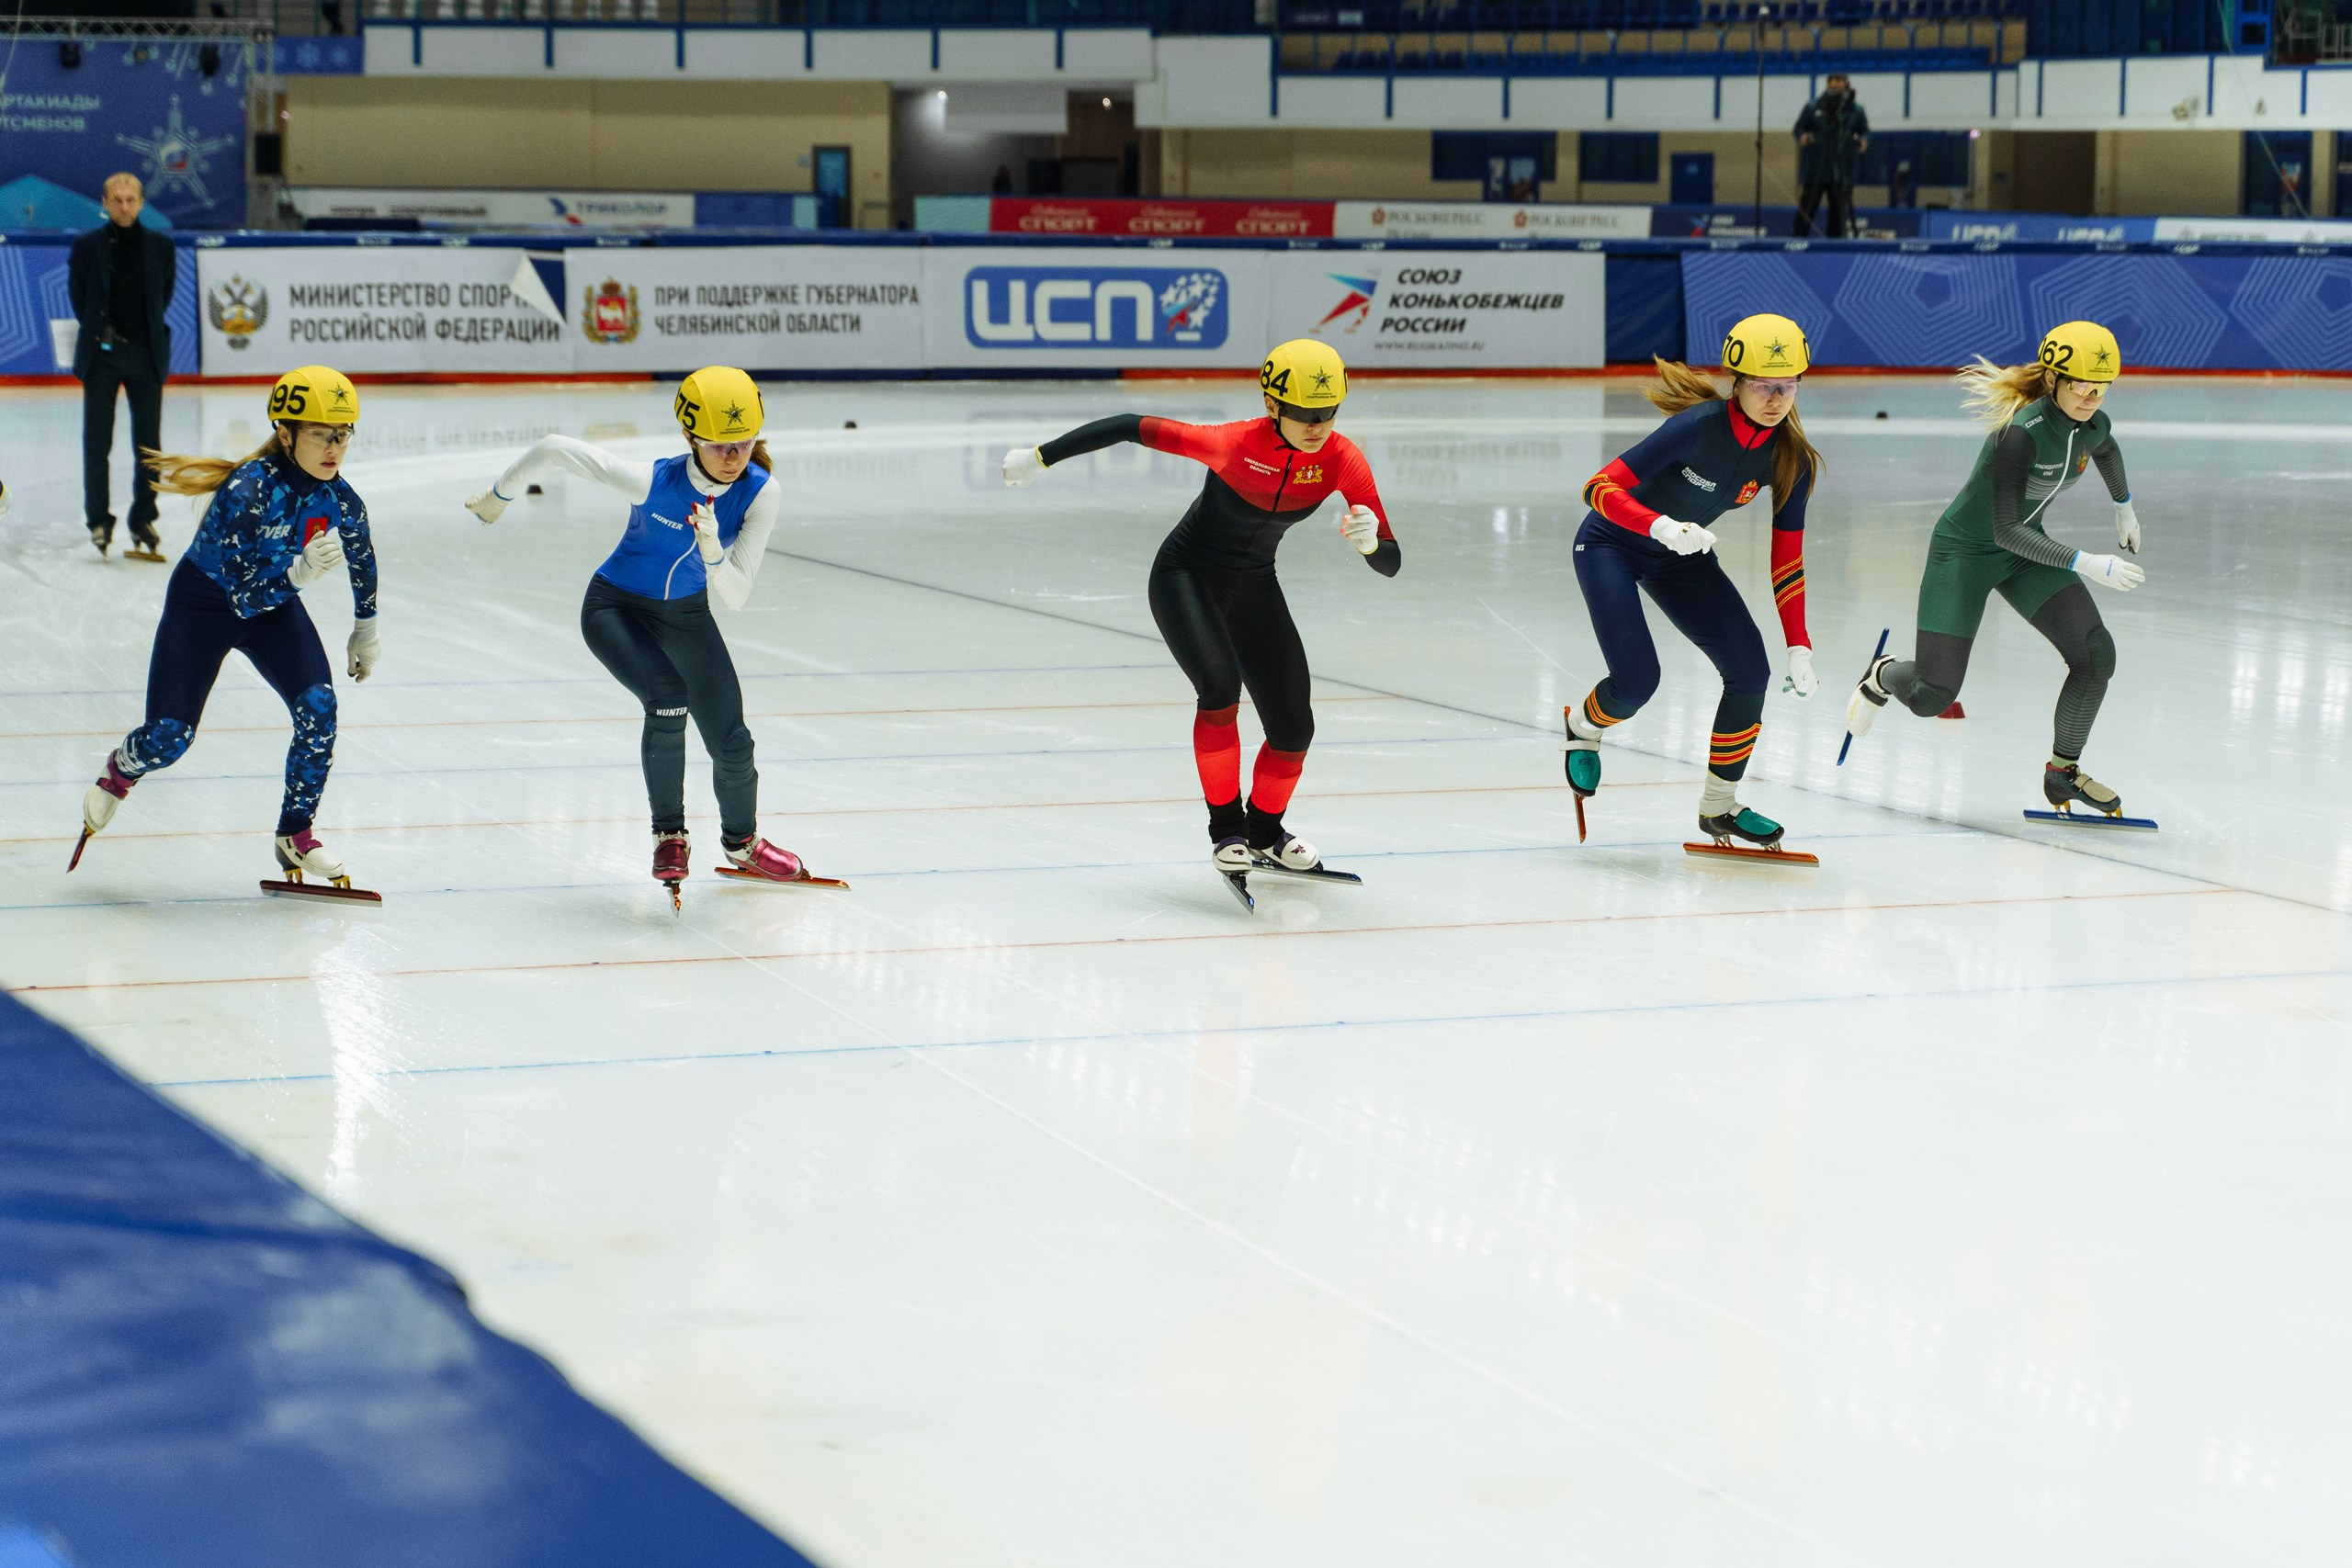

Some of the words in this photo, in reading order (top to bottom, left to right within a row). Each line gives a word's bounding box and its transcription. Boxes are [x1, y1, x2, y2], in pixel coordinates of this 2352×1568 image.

[1019, 216, 1098, 231] СПОРТ
[1128, 217, 1205, 232] СПОРТ
[1236, 218, 1311, 234] СПОРТ
[1397, 269, 1462, 285] СОЮЗ
[289, 283, 451, 308] МИНИСТЕРСТВО
[460, 284, 529, 309] СПОР
[655, 287, 689, 305] ПРИ
[696, 286, 798, 307] ПОДДЕРЖКЕ
[807, 285, 919, 306] ГУБЕРНАТОРА
[1388, 293, 1564, 311] КОНЬКОБЕЖЦЕВ
[972, 279, 1154, 341] ЦСП
[289, 313, 427, 343] РОССИЙСКОЙ
[435, 318, 561, 344] ФЕДЕРАЦИИ
[655, 310, 780, 335] ЧЕЛЯБИНСКОЙ
[786, 314, 861, 333] ОБЛАСТИ
[1380, 318, 1466, 333] РОССИИ
[2039, 337, 2074, 372] 62
[1261, 360, 1291, 397] 84
[267, 384, 310, 415] 95
[674, 387, 700, 431] 75
[1244, 457, 1281, 472] СВЕРДЛОВСКАЯ
[1250, 465, 1272, 476] ОБЛАСТЬ
[651, 513, 684, 530] HUNTER
[656, 706, 688, 716] HUNTER
